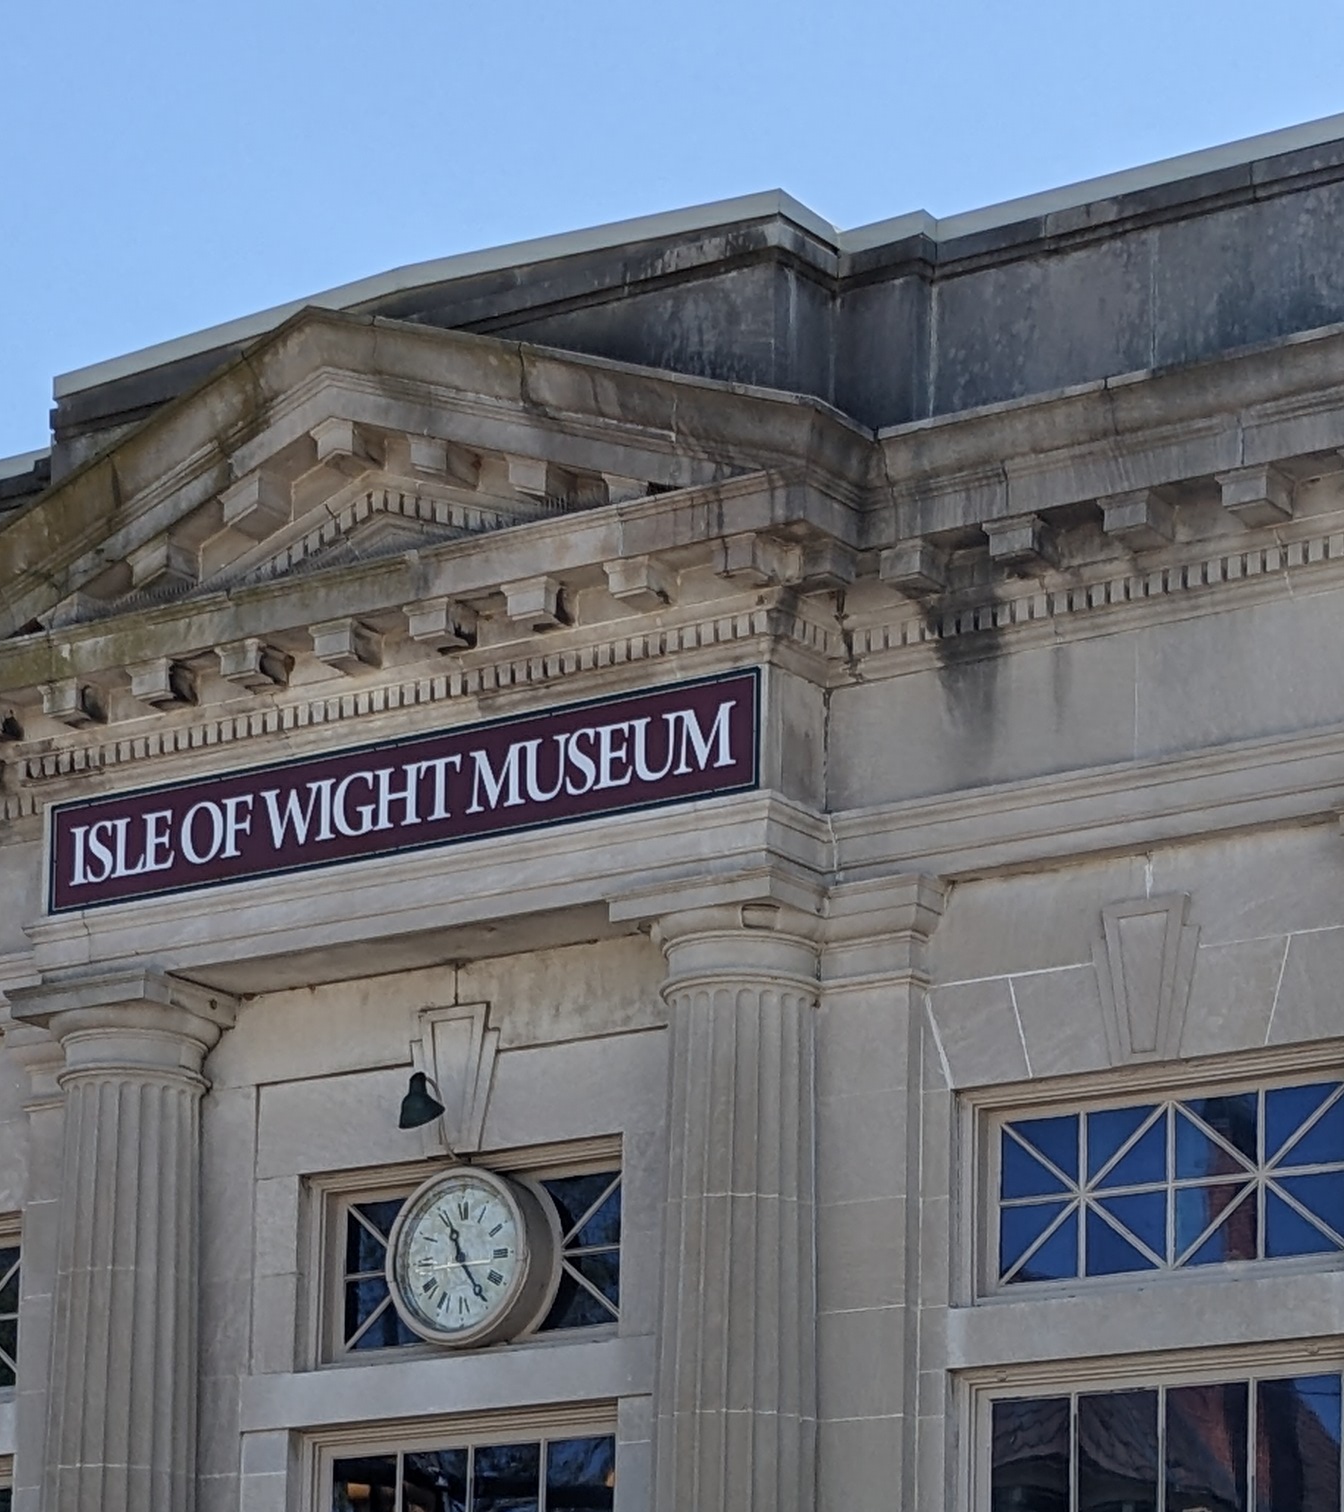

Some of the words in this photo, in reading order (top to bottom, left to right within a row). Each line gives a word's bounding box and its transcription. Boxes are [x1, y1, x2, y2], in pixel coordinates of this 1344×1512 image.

[69, 808, 176, 886] ISLE
[181, 794, 255, 864] OF
[261, 754, 461, 850] WIGHT
[466, 700, 737, 815] MUSEUM
